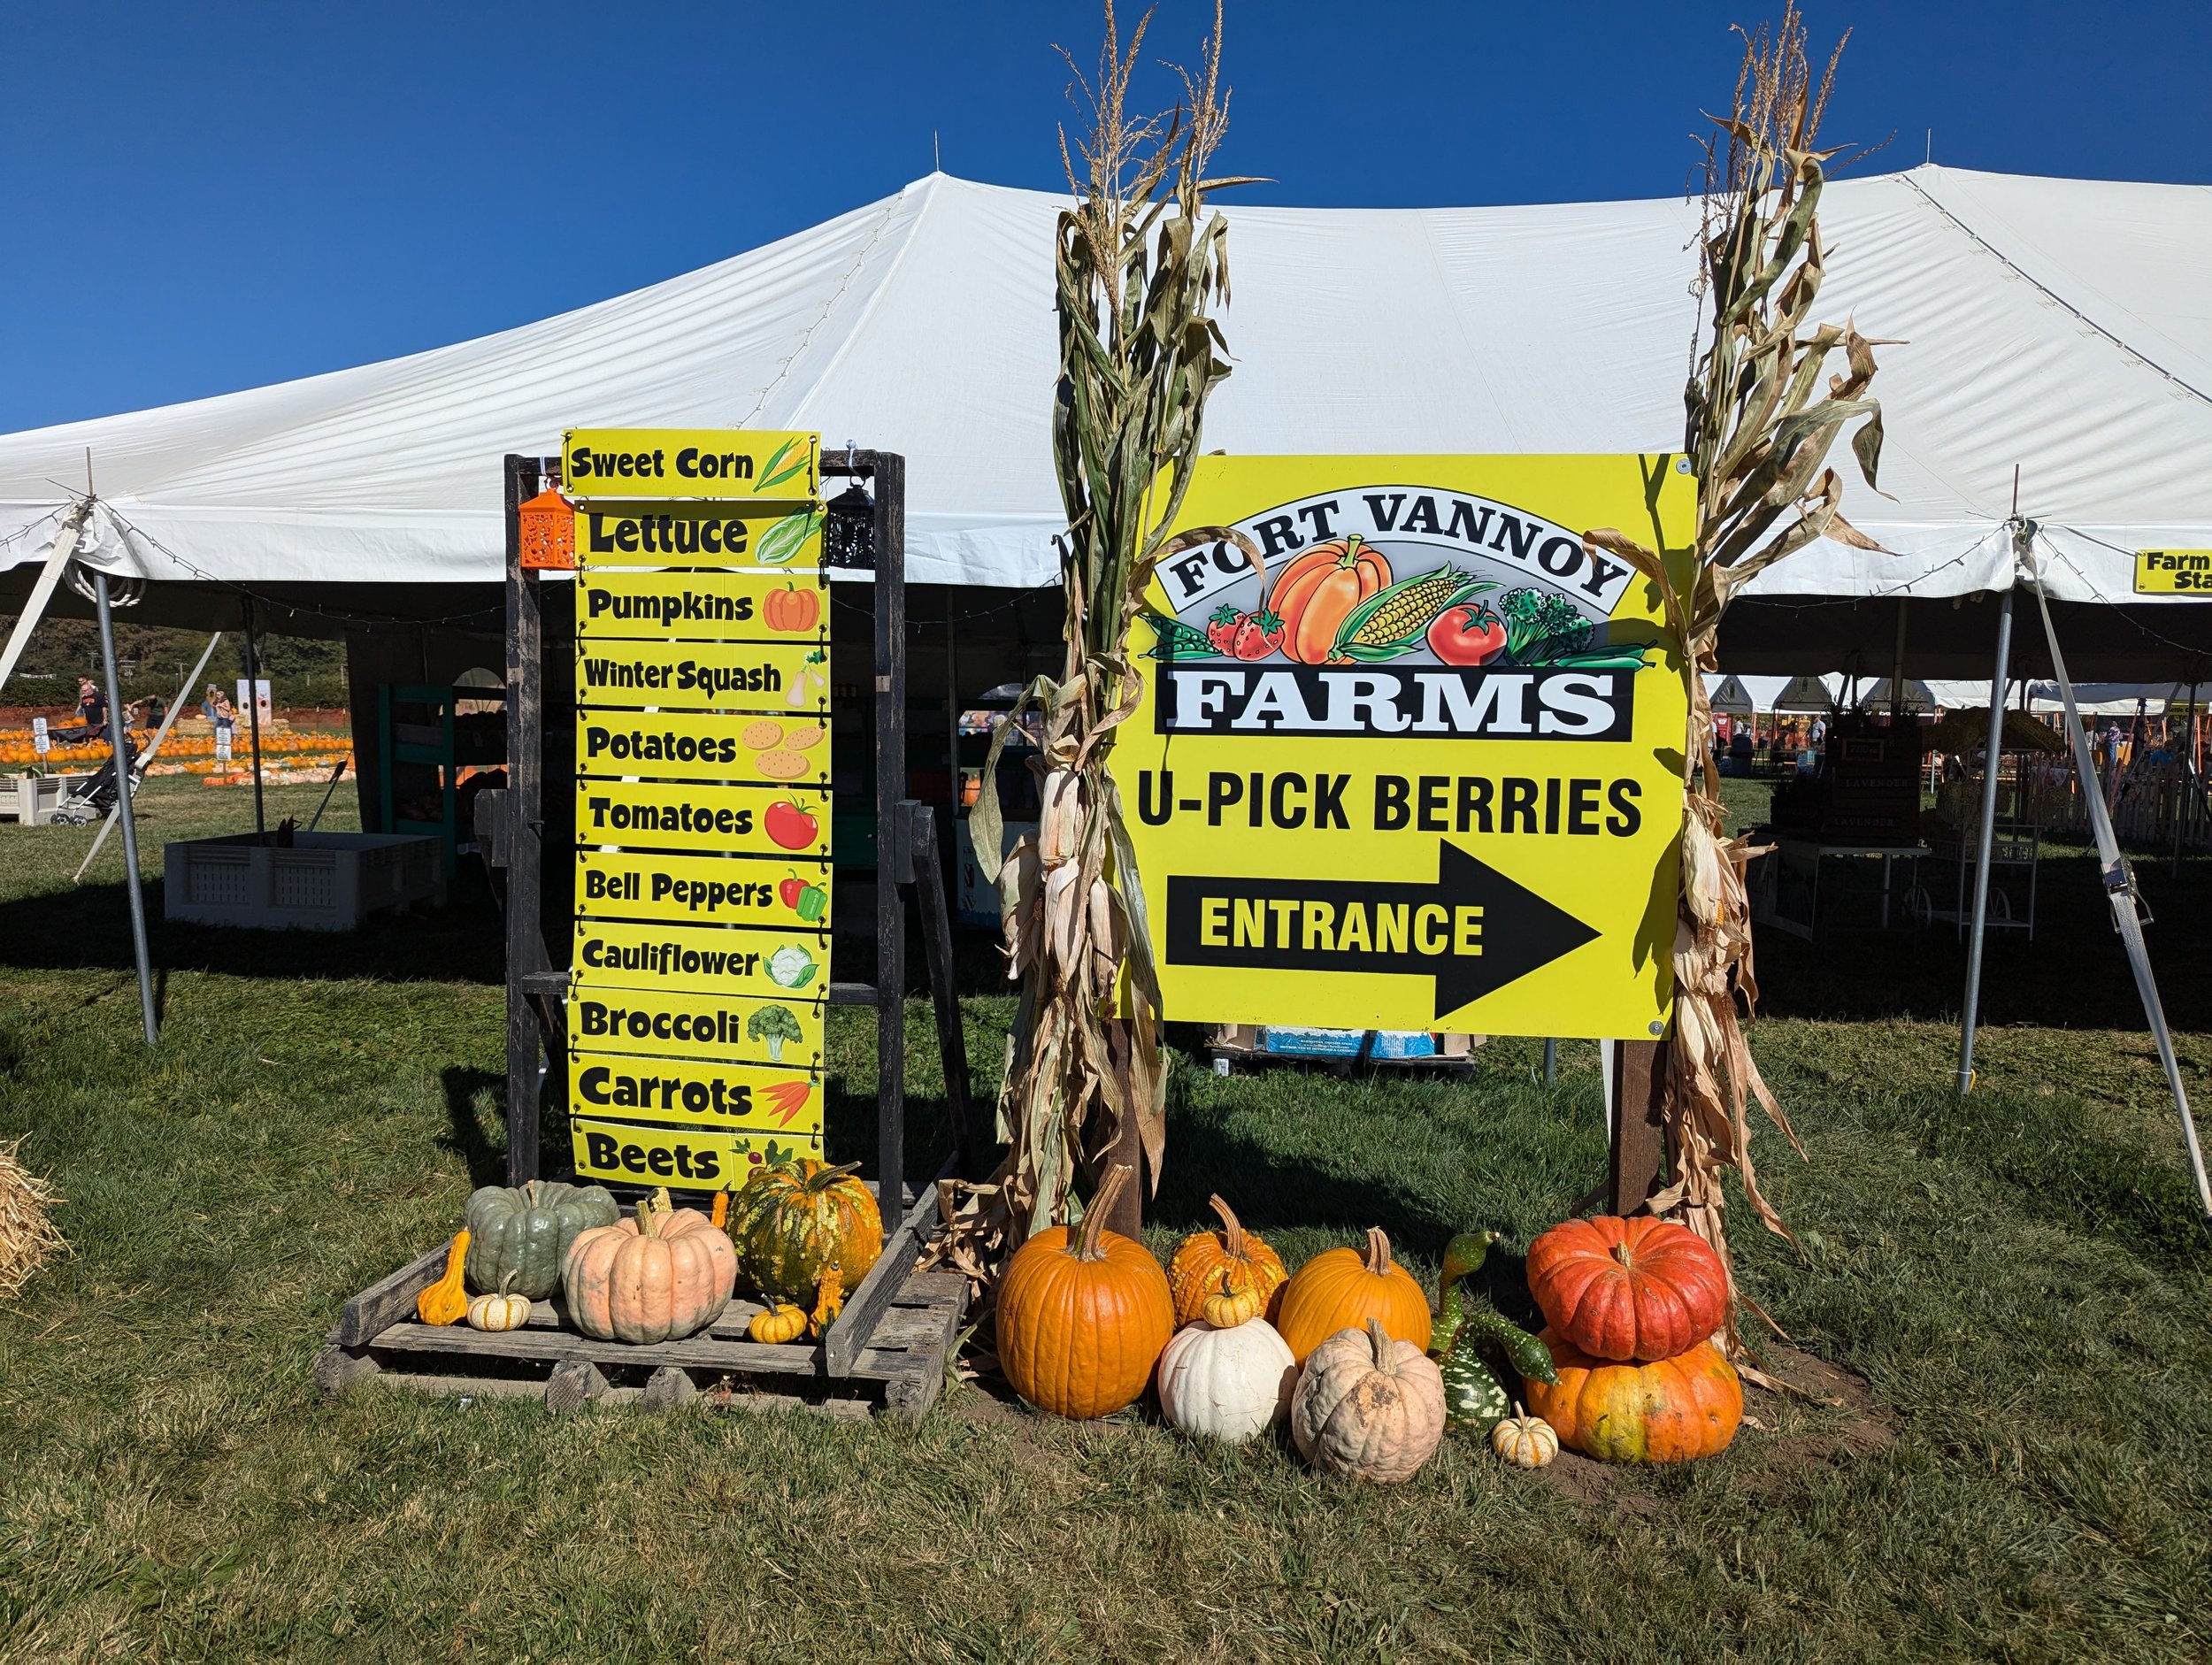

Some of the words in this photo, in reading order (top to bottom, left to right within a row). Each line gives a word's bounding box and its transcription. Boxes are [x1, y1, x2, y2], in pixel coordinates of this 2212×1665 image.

[571, 447, 664, 478] Sweet
[675, 448, 755, 480] Corn
[588, 513, 748, 555] Lettuce
[1168, 499, 1342, 598] FORT
[1363, 493, 1628, 598] VANNOY
[2147, 552, 2210, 571] Farm
[588, 588, 754, 627] Pumpkins
[583, 658, 673, 689] Winter
[677, 660, 782, 701] Squash
[1166, 670, 1617, 736] FARMS
[587, 726, 737, 763] Potatoes
[588, 796, 754, 835] Tomatoes
[1138, 769, 1352, 830] U-PICK
[1373, 774, 1643, 838] BERRIES
[586, 870, 641, 901] Bell
[651, 872, 773, 912] Peppers
[1201, 897, 1485, 956] ENTRANCE
[581, 939, 760, 977] Cauliflower
[580, 1001, 740, 1044] Broccoli
[578, 1066, 753, 1116] Carrots
[585, 1131, 721, 1181] Beets
